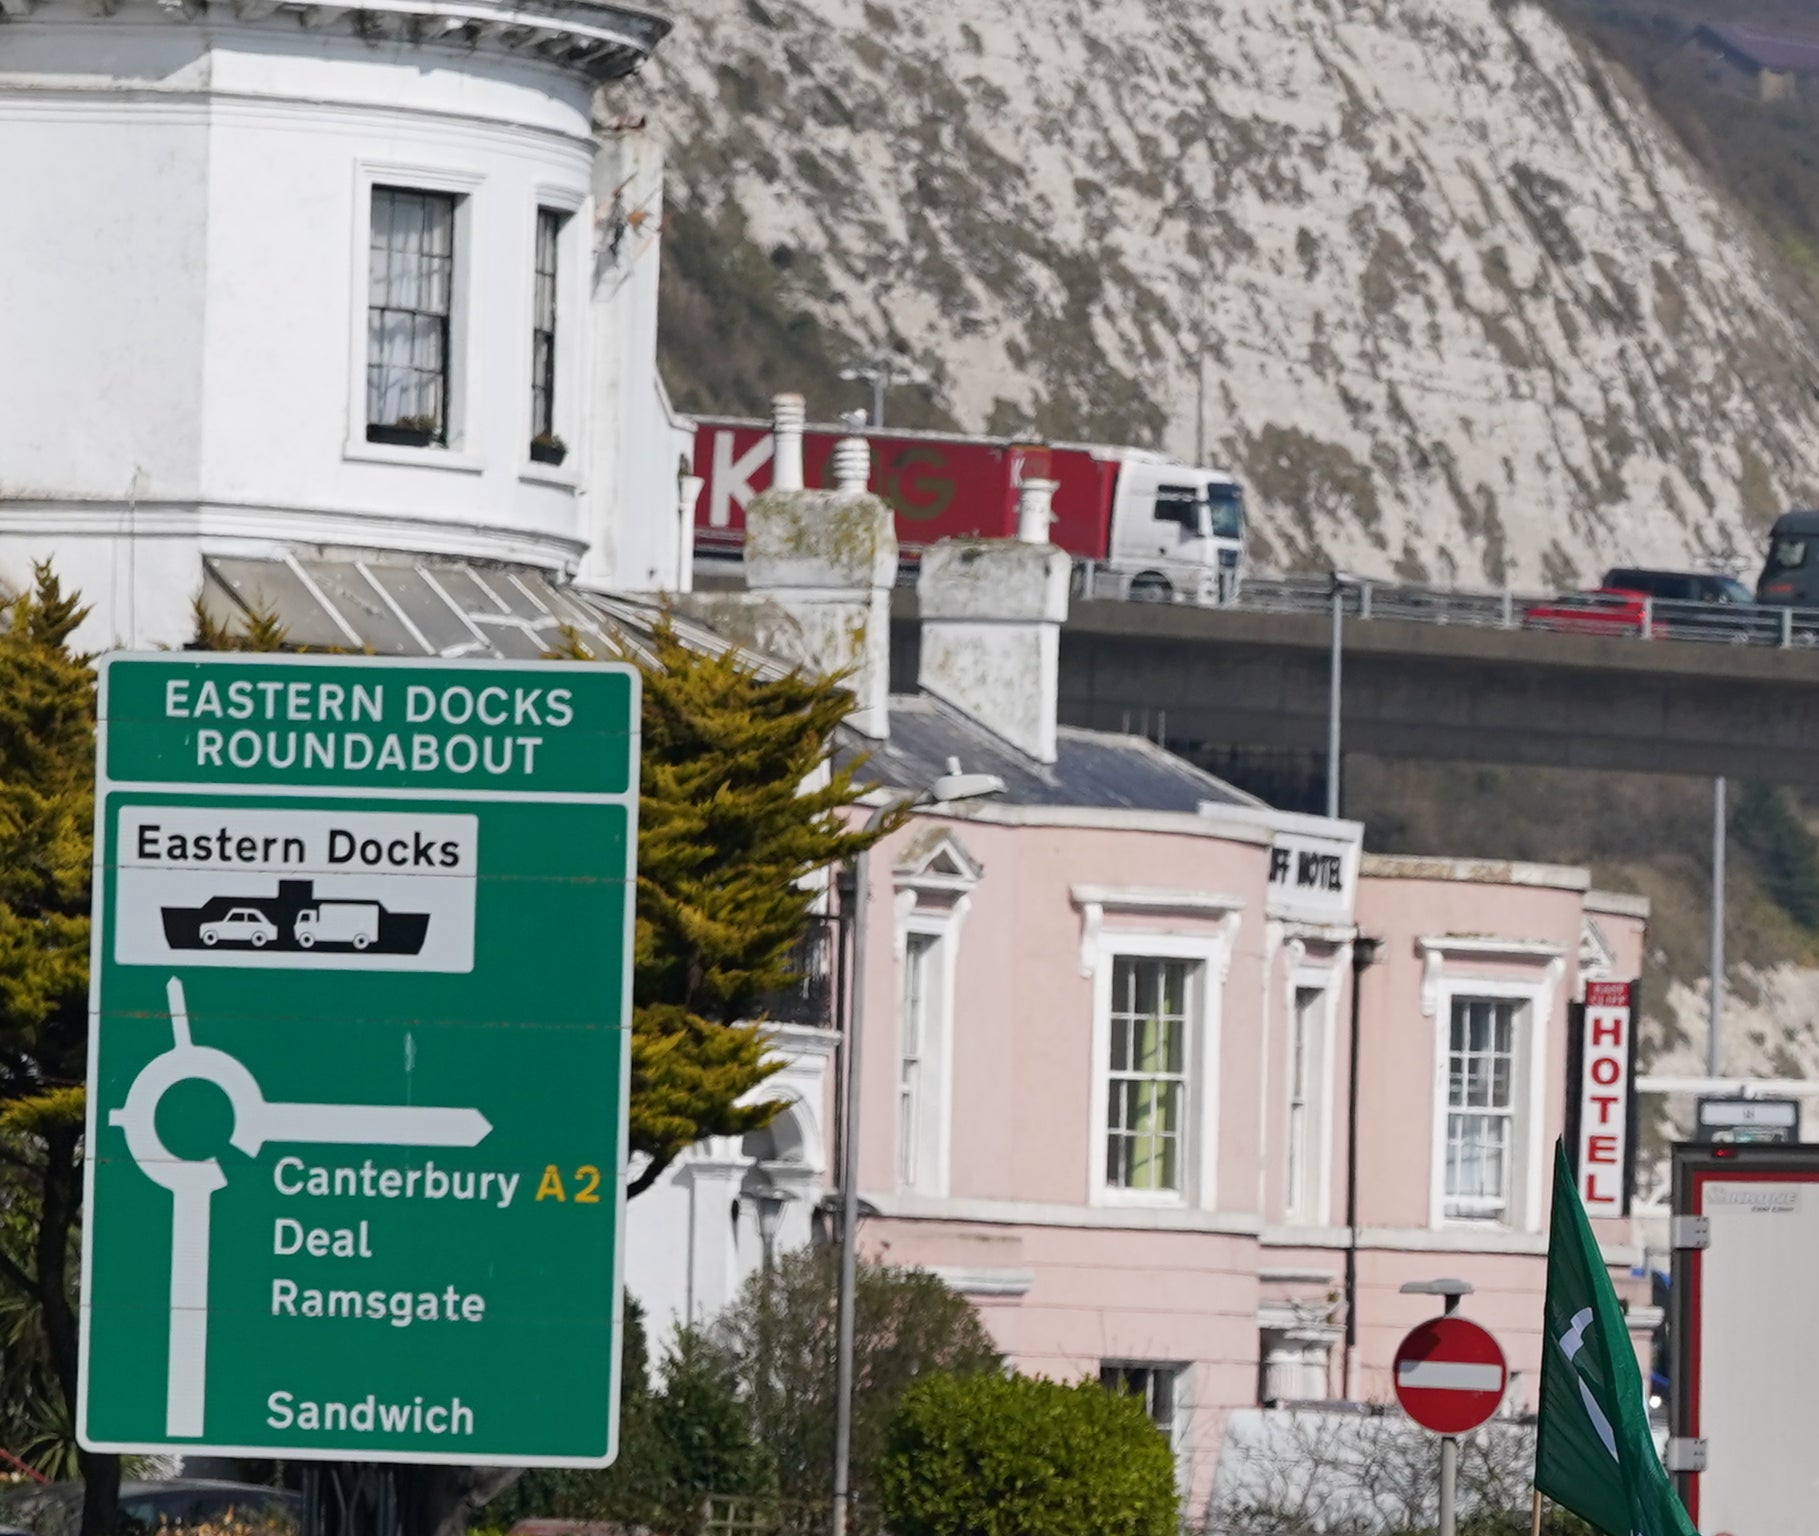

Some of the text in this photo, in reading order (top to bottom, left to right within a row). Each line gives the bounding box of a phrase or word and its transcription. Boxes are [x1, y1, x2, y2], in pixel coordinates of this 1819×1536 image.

[165, 680, 573, 726] EASTERN DOCKS
[196, 729, 543, 775] ROUNDABOUT
[137, 824, 460, 867] Eastern Docks
[1585, 1018, 1622, 1203] HOTEL
[272, 1157, 520, 1208] Canterbury
[273, 1218, 372, 1259] Deal
[271, 1279, 486, 1328] Ramsgate
[266, 1391, 475, 1435] Sandwich
